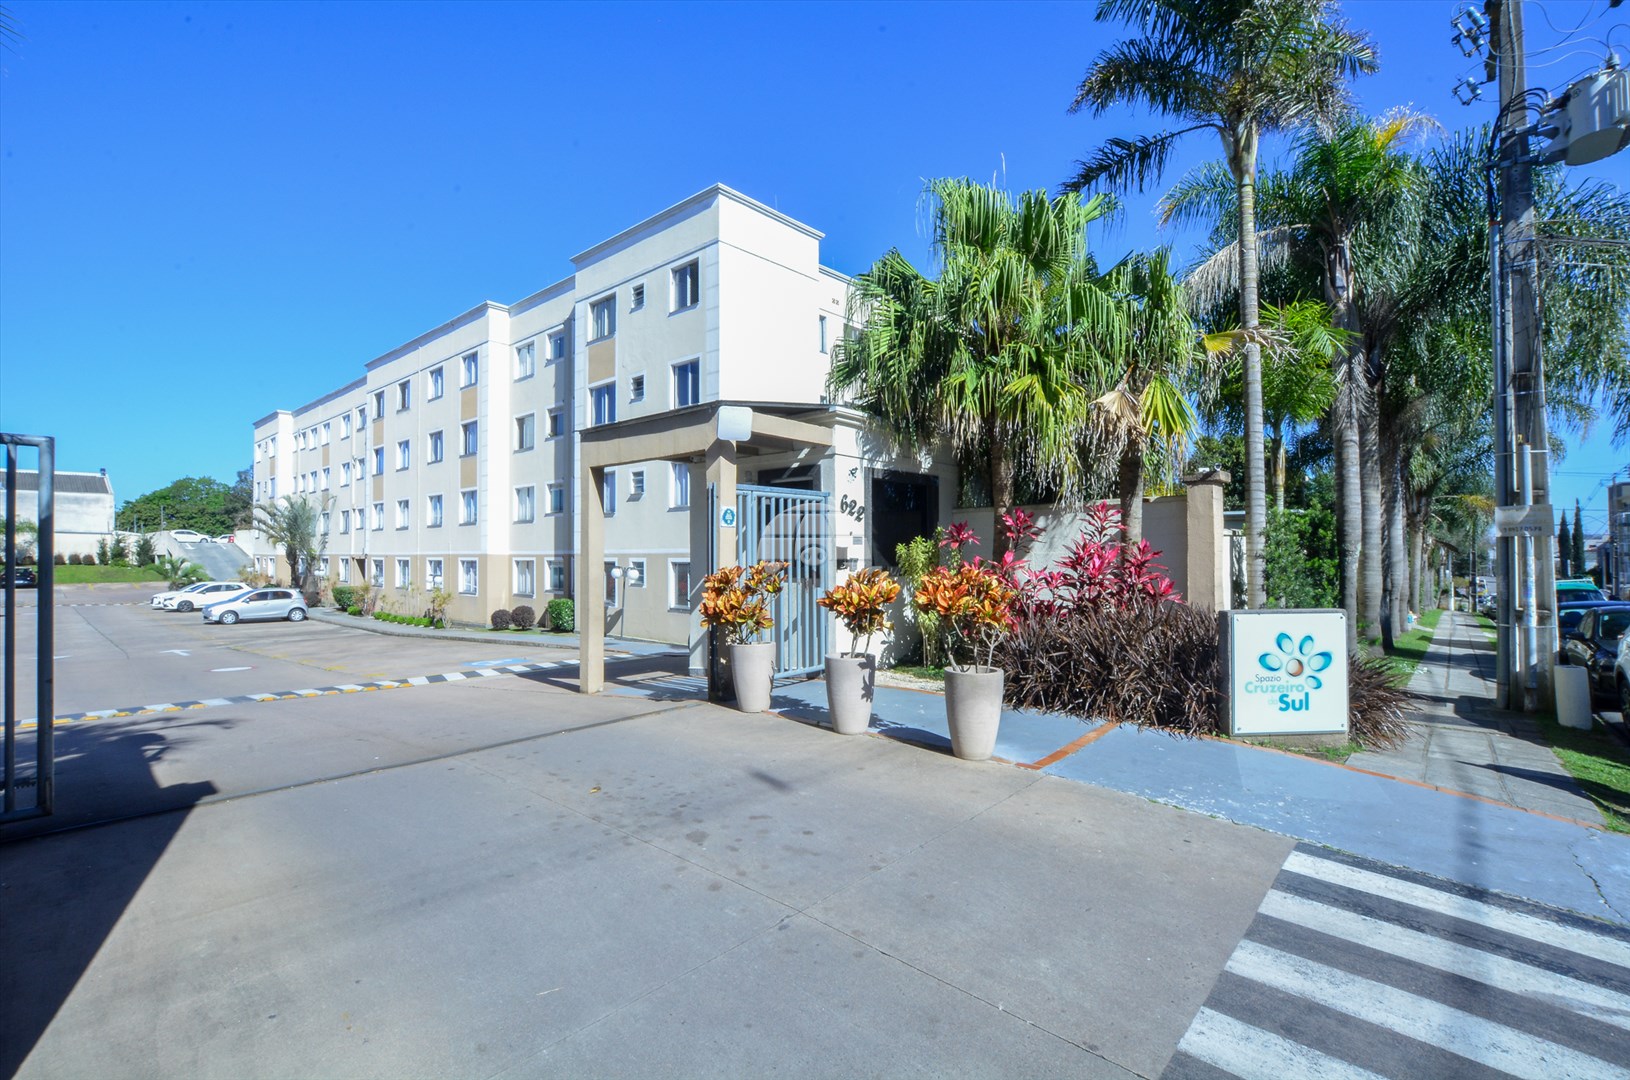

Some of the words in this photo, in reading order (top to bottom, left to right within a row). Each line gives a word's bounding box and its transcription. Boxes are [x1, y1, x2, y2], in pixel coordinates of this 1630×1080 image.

[840, 494, 866, 522] 622
[1244, 680, 1305, 694] Cruzeiro
[1255, 673, 1282, 684] Spazio
[1278, 691, 1310, 712] Sul
